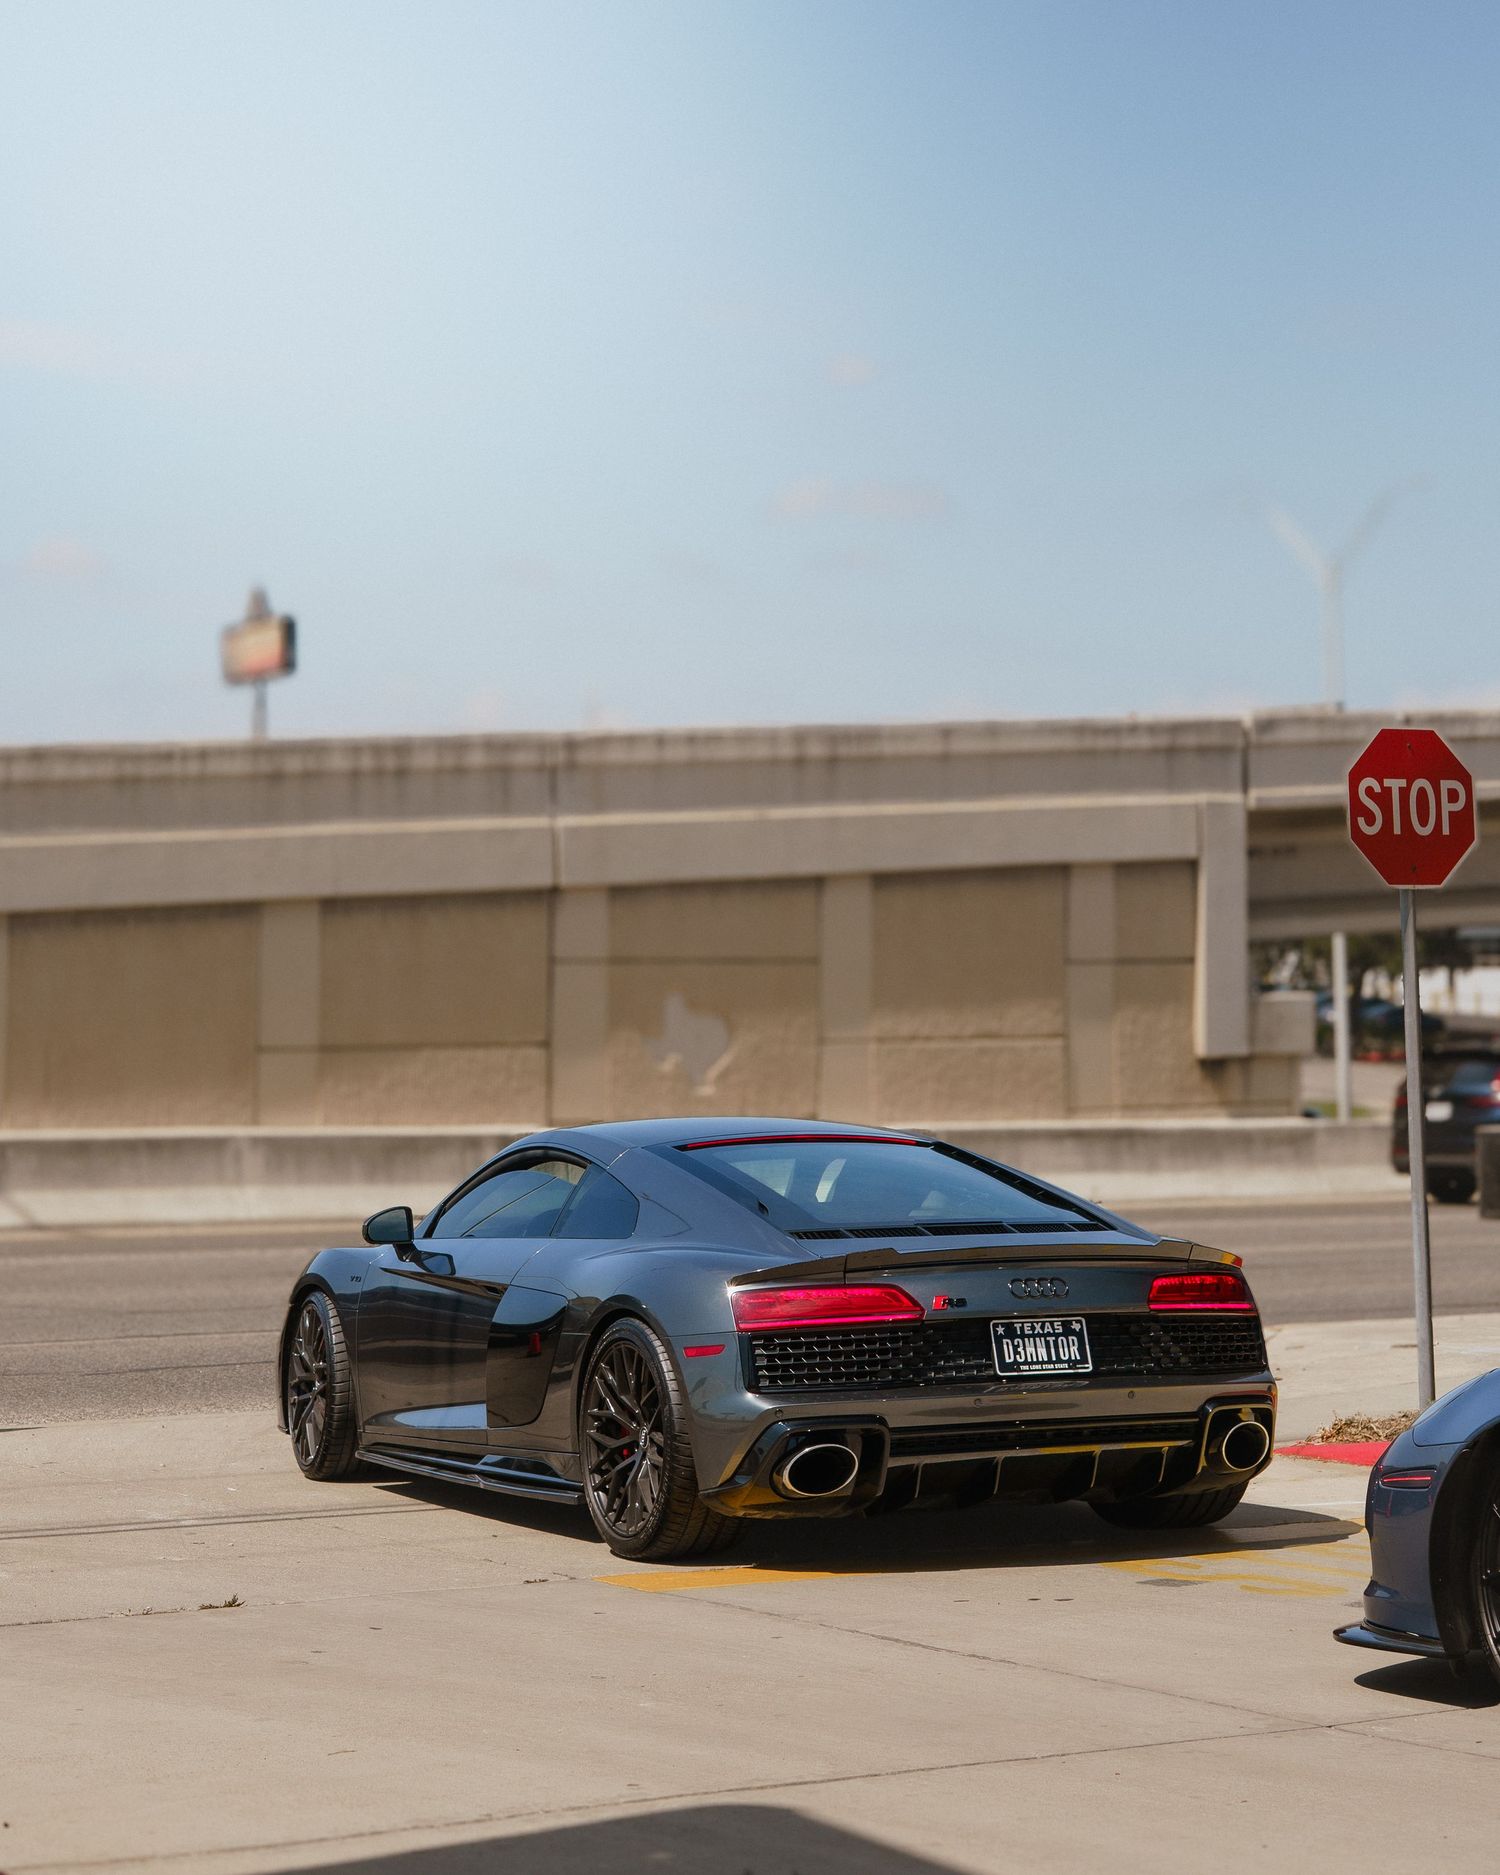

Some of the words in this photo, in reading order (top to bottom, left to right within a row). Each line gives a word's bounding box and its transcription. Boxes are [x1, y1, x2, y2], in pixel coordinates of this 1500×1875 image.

[1357, 777, 1467, 836] STOP
[1014, 1322, 1063, 1334] TEXAS
[1002, 1336, 1080, 1363] D3MNTOR
